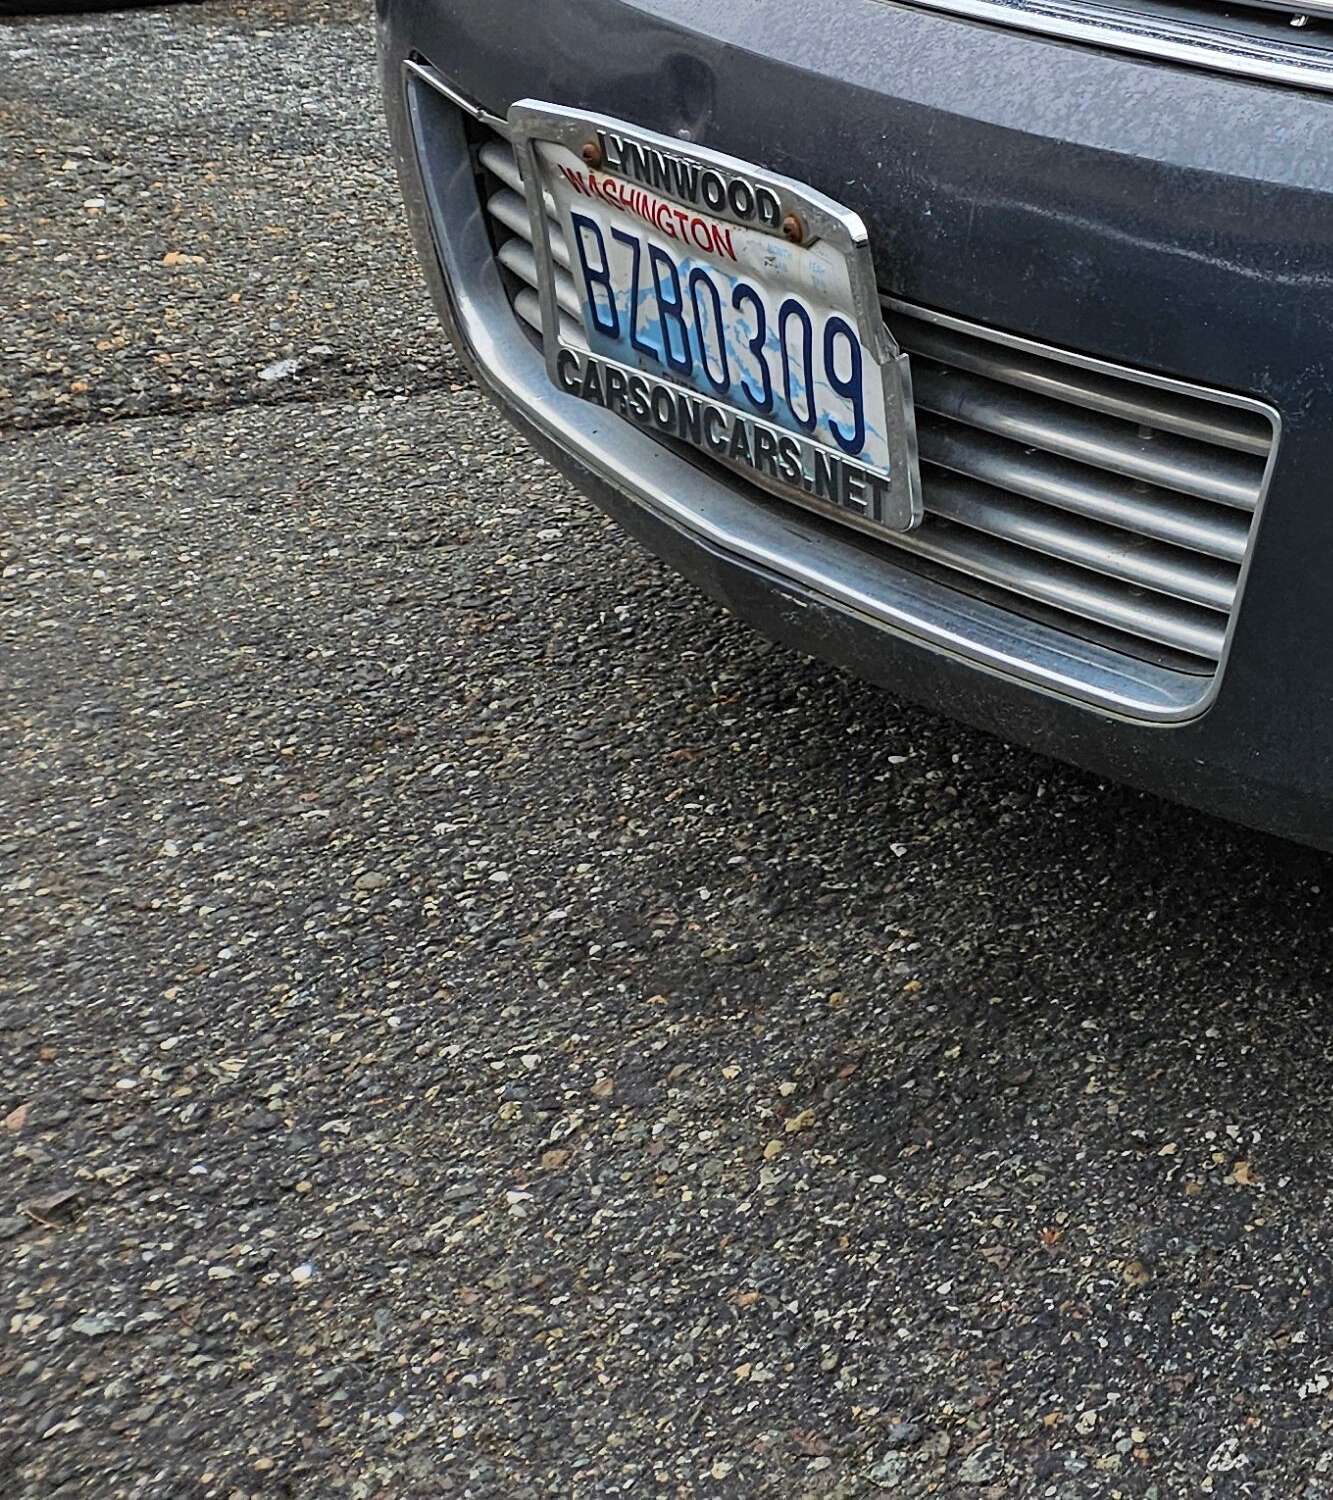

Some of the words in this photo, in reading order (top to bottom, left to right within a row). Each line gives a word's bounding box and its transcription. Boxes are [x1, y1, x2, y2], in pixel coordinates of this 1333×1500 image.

[557, 163, 738, 262] WASHINGTON
[596, 129, 781, 228] LYNNWOOD
[570, 210, 867, 457] BZB0309
[556, 348, 891, 523] CARSONCARS.NET
